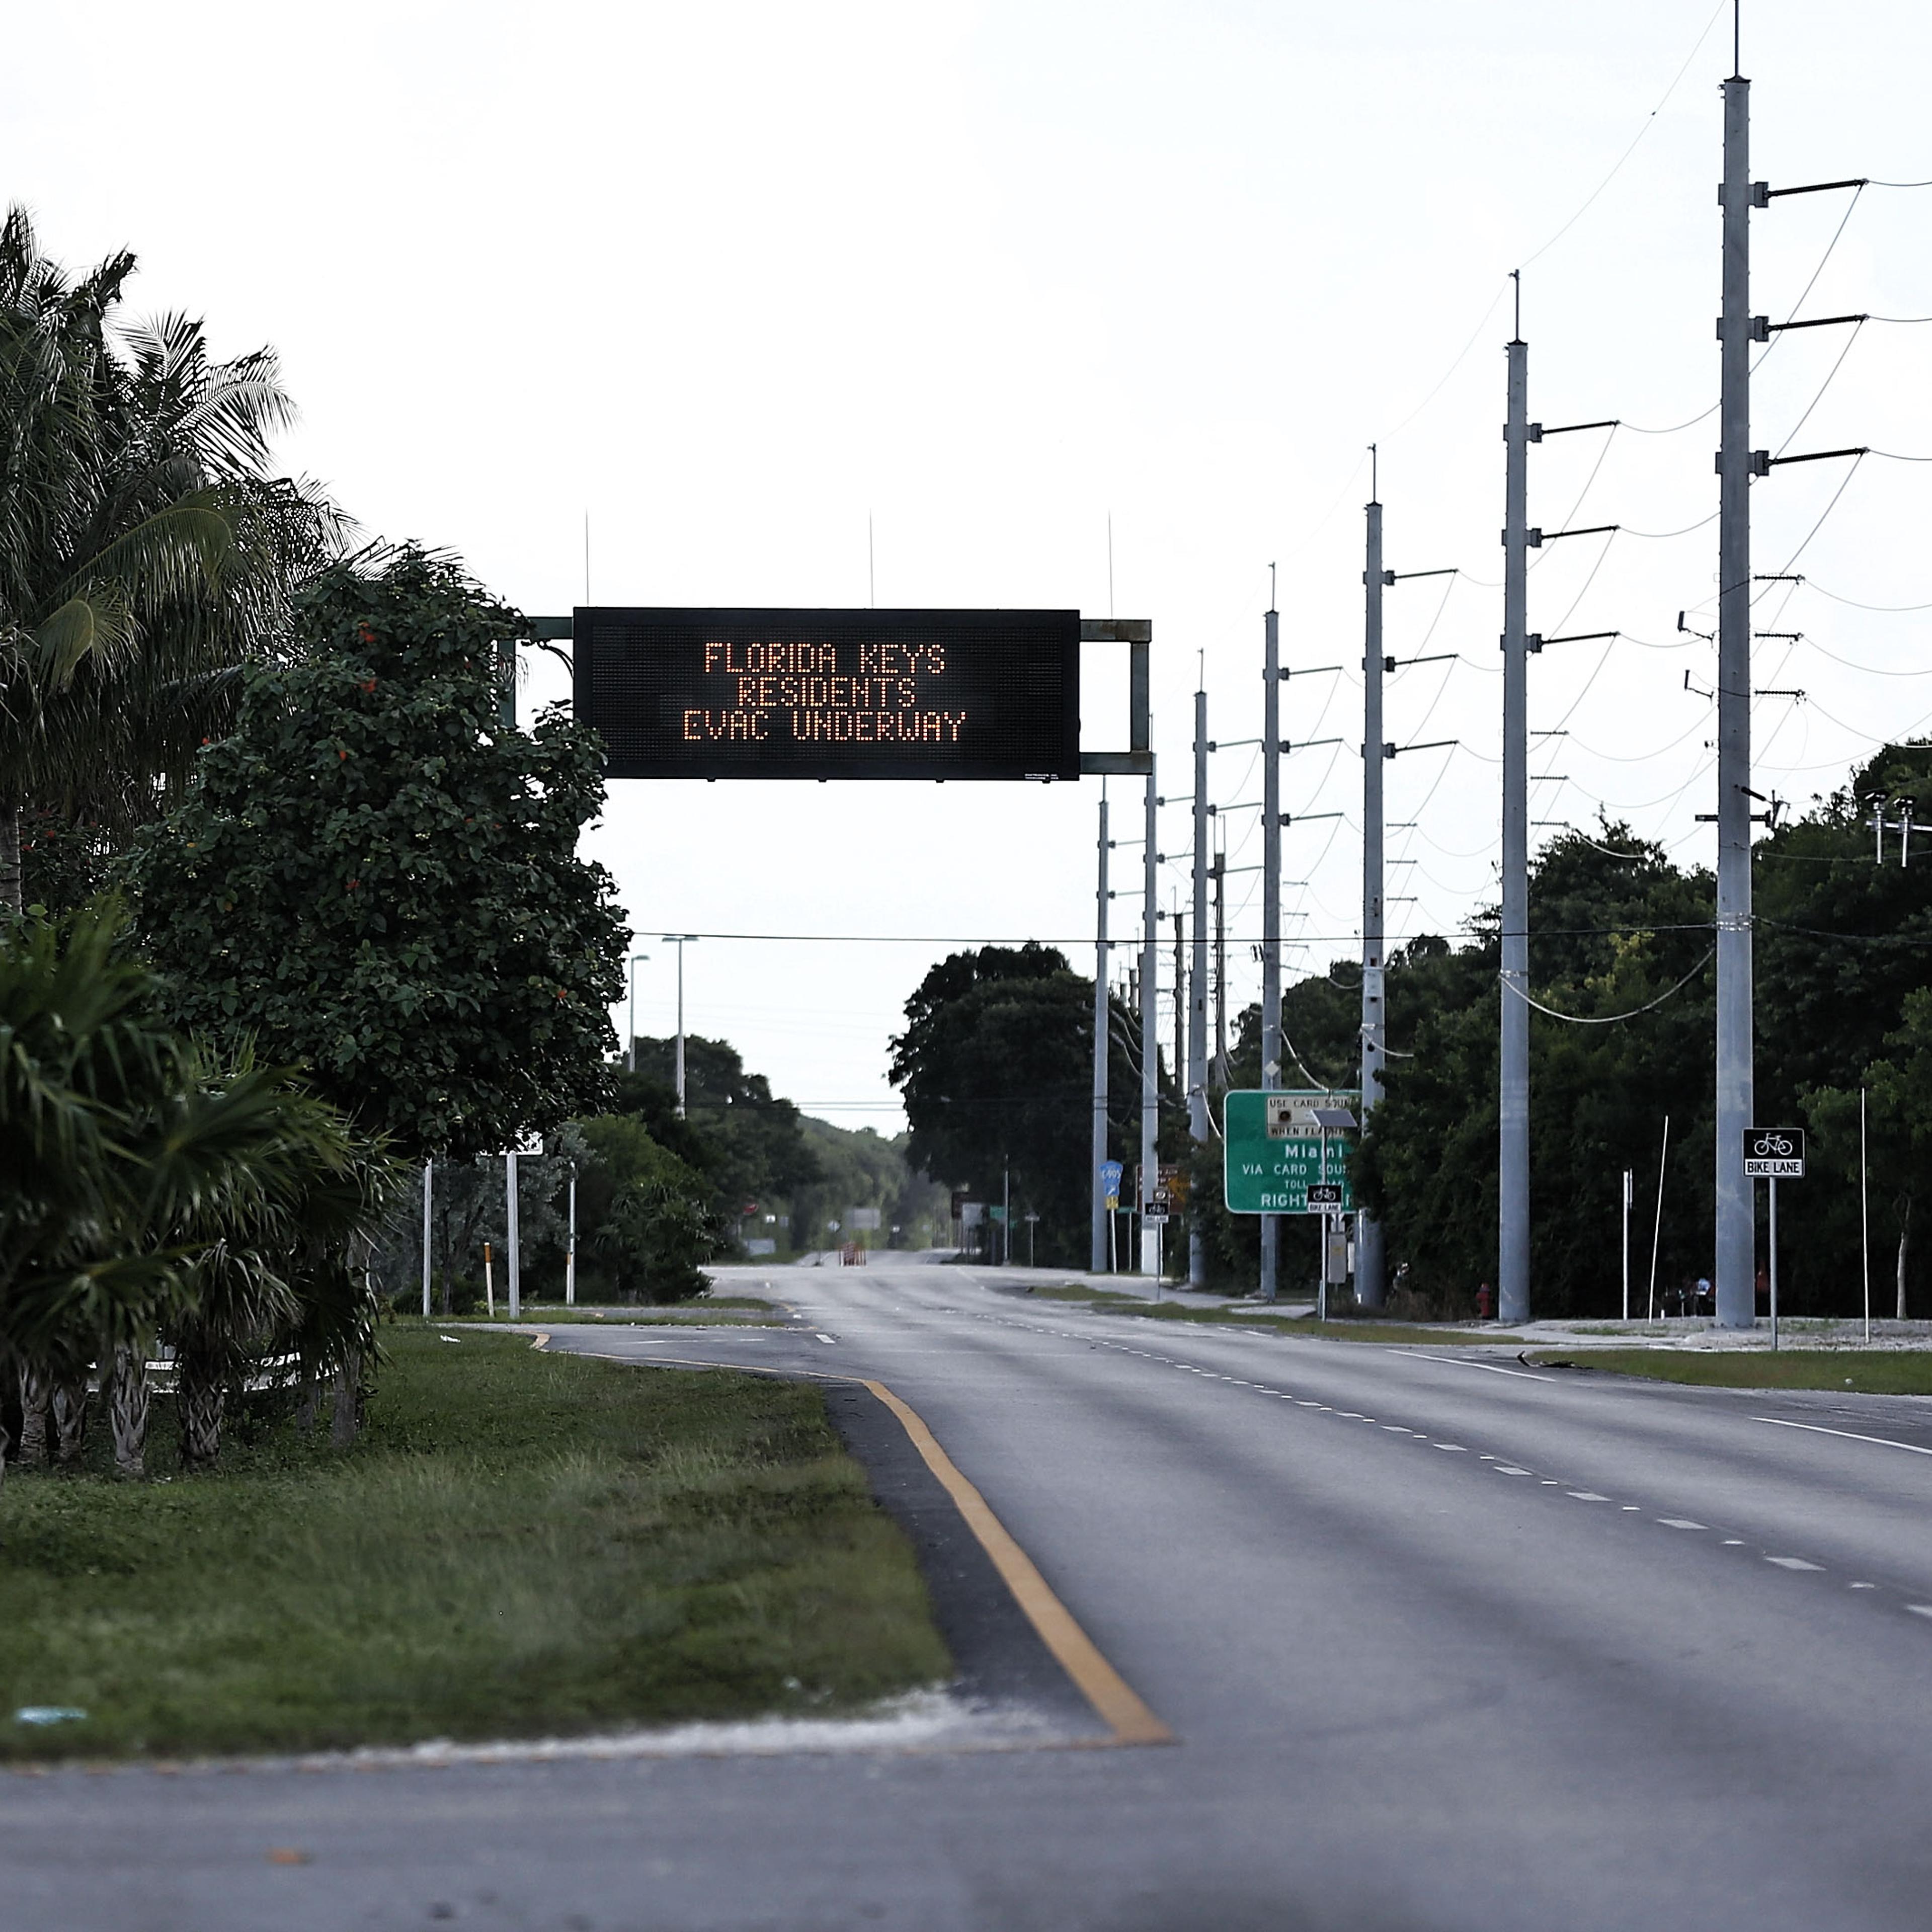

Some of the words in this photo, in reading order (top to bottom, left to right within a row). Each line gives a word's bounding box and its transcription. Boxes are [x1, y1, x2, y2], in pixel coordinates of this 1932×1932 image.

[705, 642, 836, 674] FLORIDA
[860, 642, 945, 674] KEYS
[736, 677, 915, 707] RESIDENTS
[683, 710, 769, 741] EVAC
[793, 710, 965, 741] UNDERWAY
[1242, 1164, 1263, 1175] VIA
[1273, 1164, 1307, 1175] CARD
[1747, 1162, 1769, 1173] BIKE
[1774, 1162, 1800, 1173] LANE
[1284, 1180, 1307, 1189] TOLL
